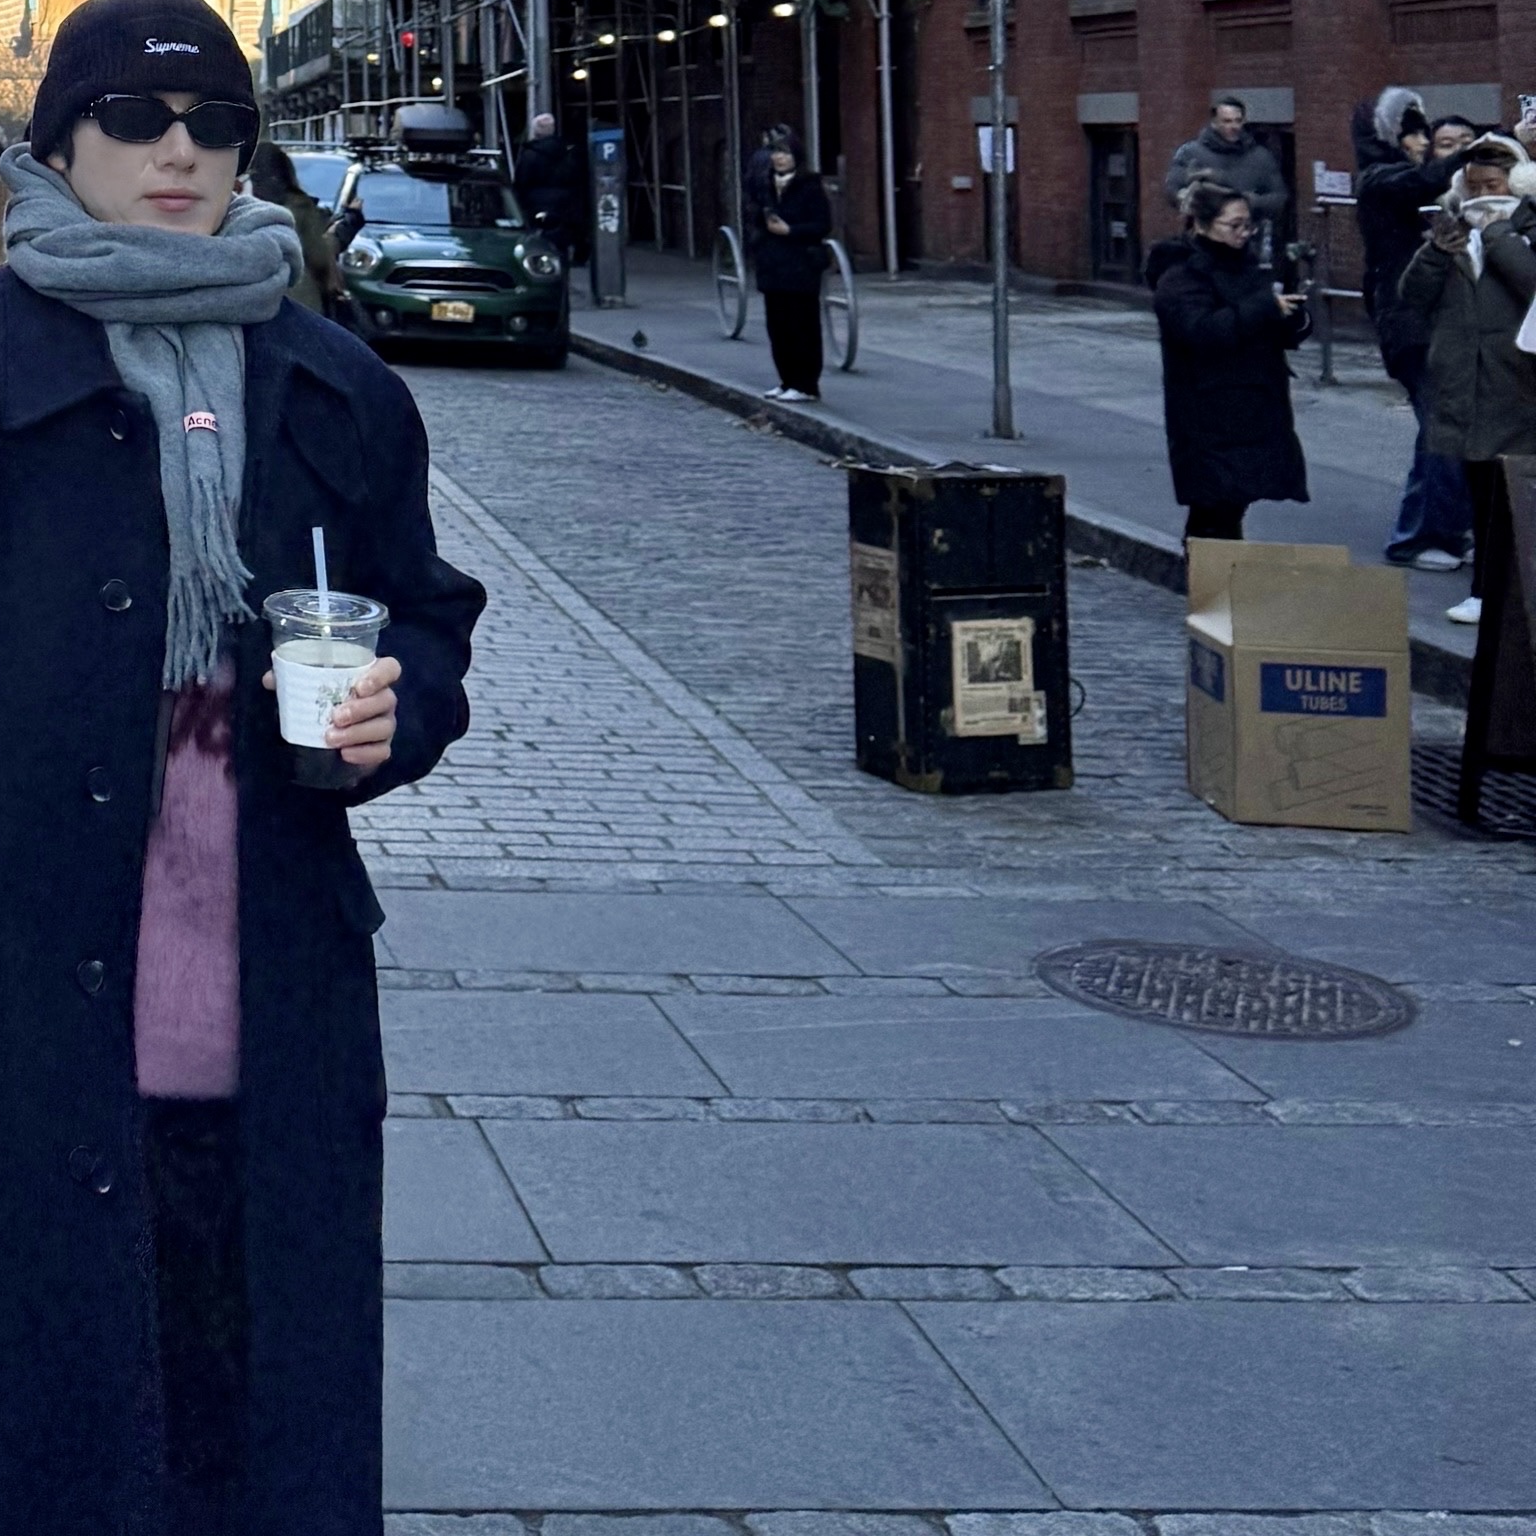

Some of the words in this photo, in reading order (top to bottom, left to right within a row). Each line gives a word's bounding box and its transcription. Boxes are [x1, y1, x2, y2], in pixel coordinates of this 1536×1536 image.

[144, 38, 200, 56] Supreme
[603, 143, 616, 160] P
[1285, 669, 1363, 694] ULINE
[1301, 695, 1348, 712] TUBES
